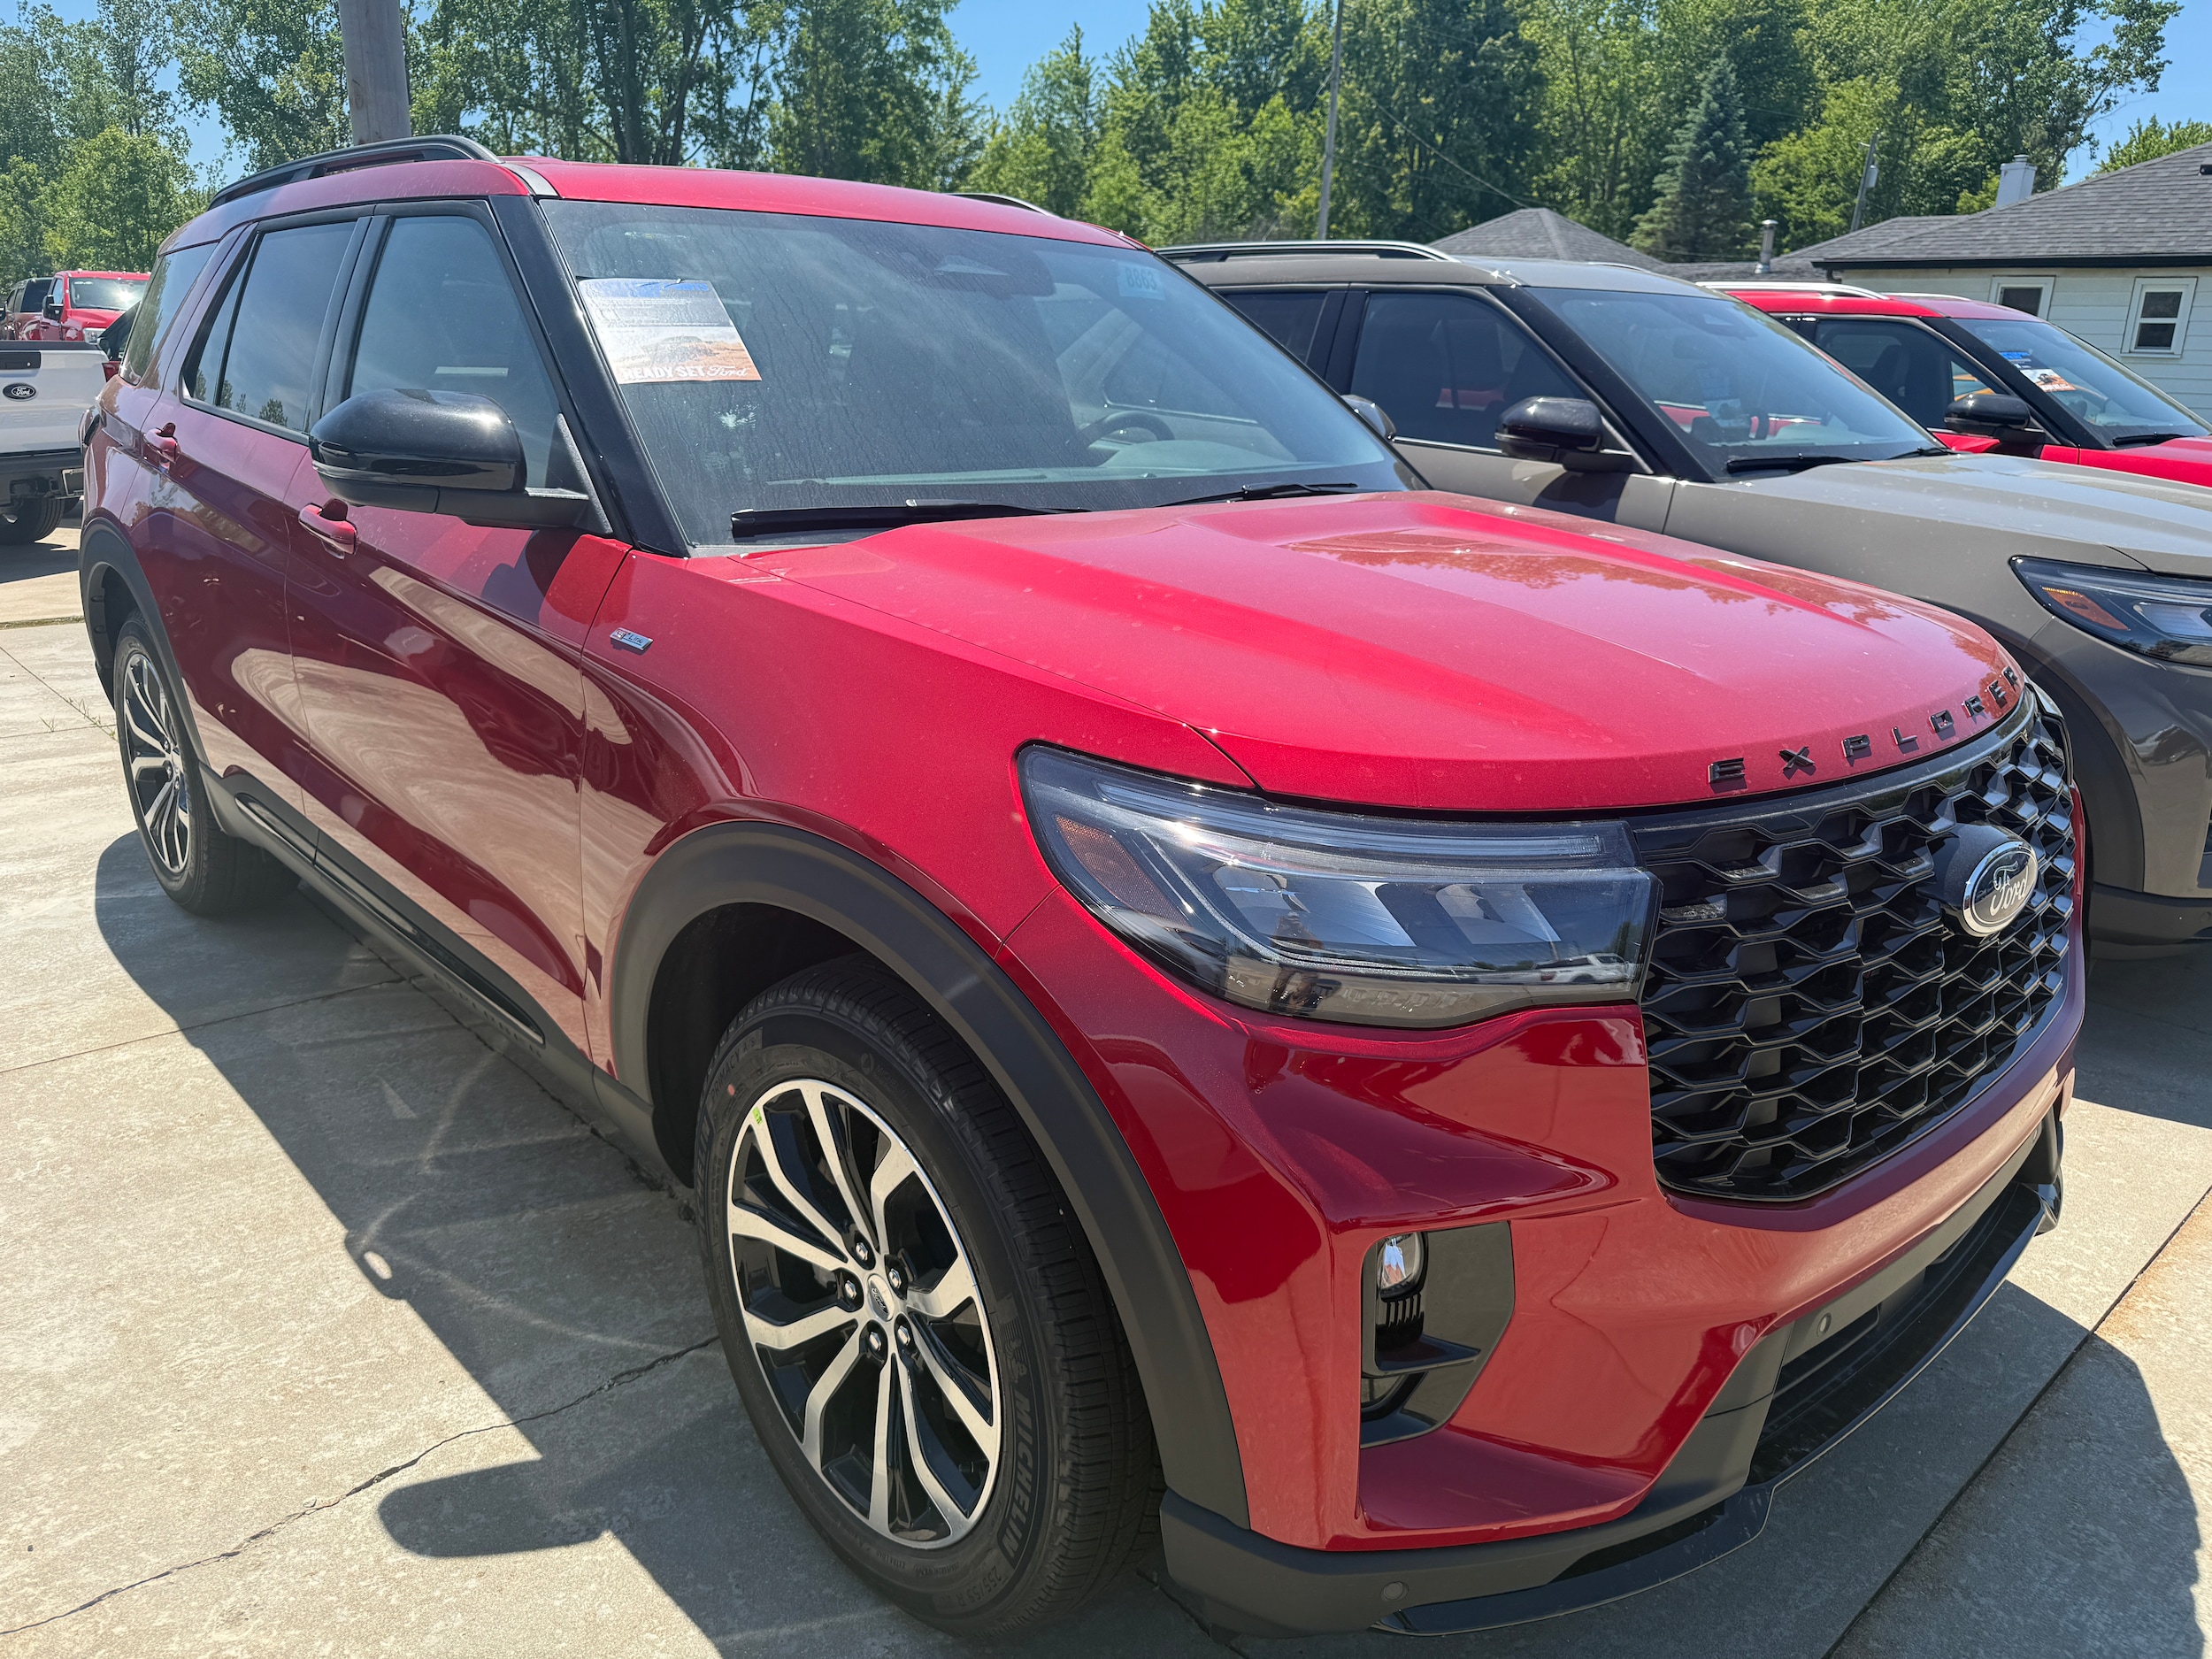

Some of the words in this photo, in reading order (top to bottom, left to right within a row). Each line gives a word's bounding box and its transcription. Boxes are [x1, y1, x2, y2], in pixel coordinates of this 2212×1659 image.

[620, 365, 674, 380] READY
[676, 365, 706, 378] SET
[707, 365, 749, 378] Ford
[1708, 666, 2018, 785] EXPLORER
[1989, 860, 2030, 917] Ford
[1001, 1389, 1033, 1558] MICHELIN
